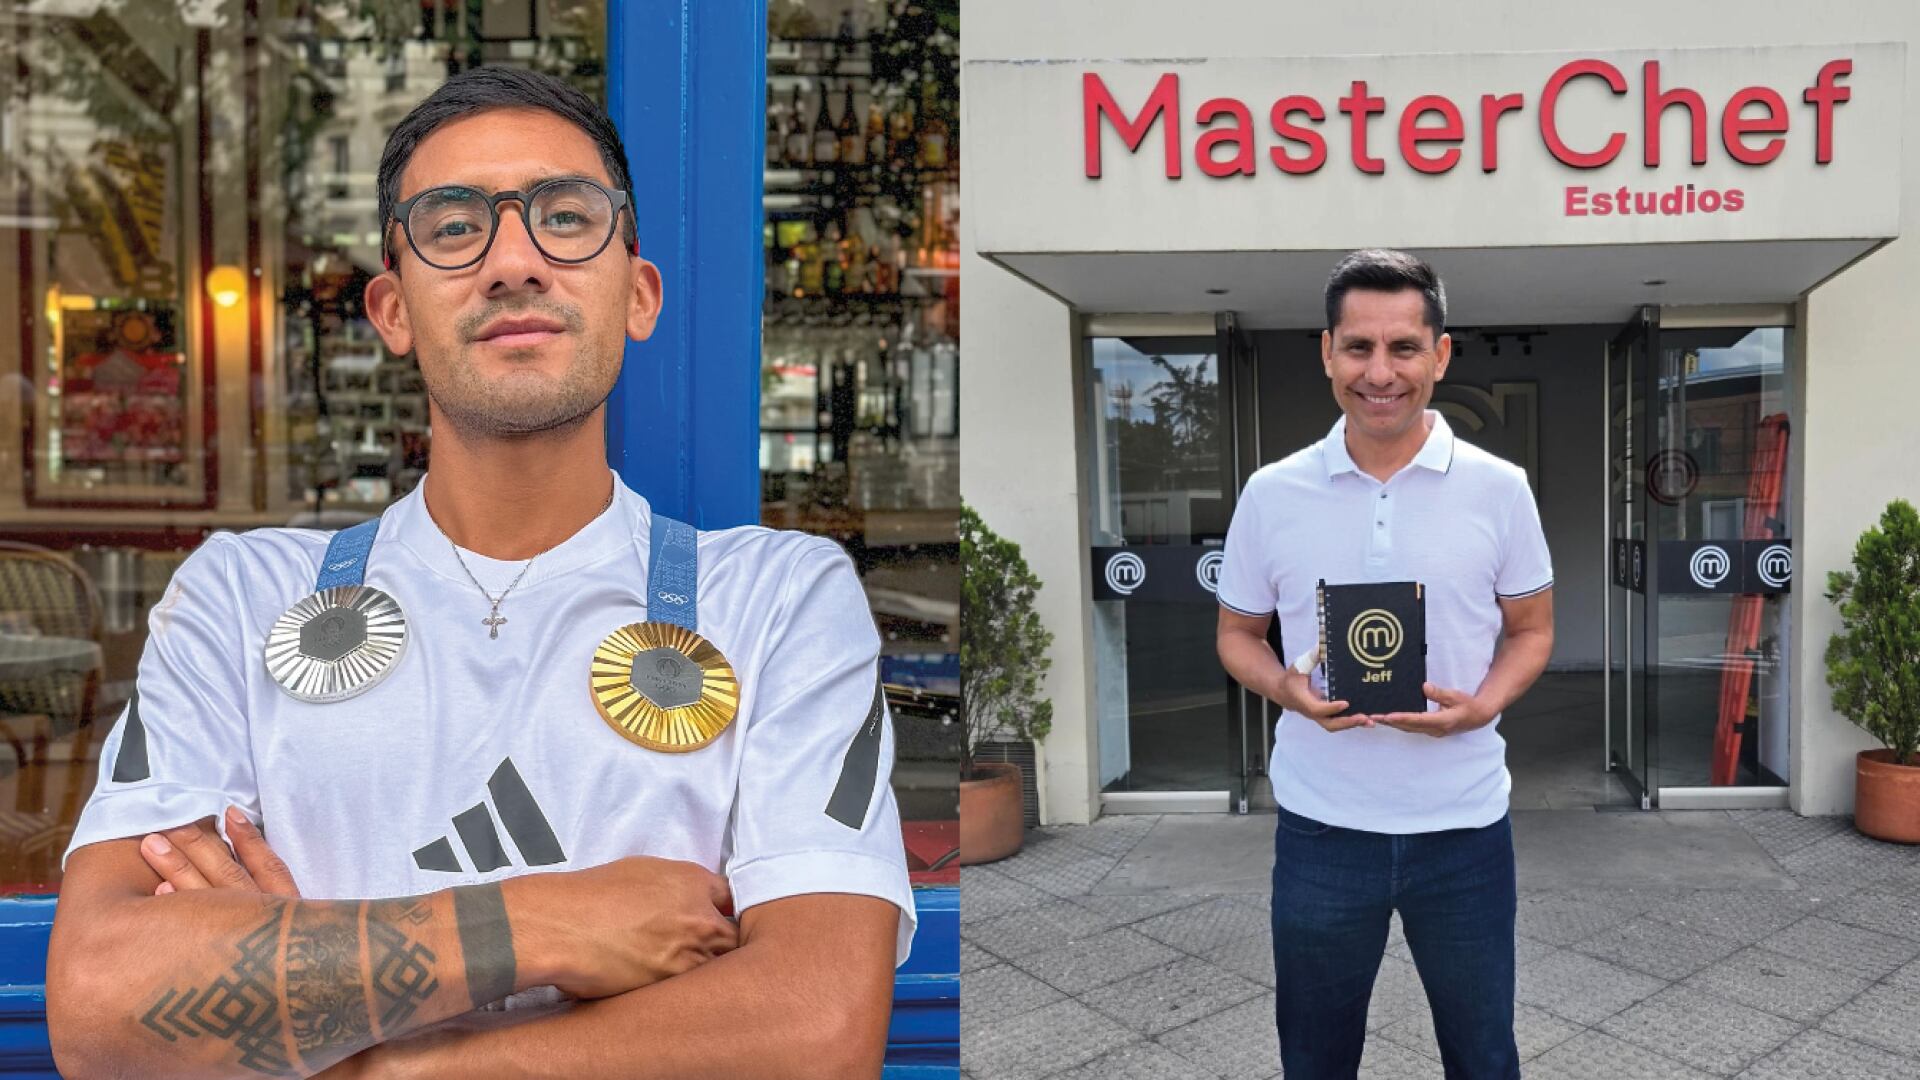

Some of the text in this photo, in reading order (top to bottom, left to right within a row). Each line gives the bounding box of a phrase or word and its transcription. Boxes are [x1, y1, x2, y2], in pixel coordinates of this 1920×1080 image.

[1083, 59, 1853, 179] MasterChef
[1565, 184, 1744, 217] Estudios
[1361, 670, 1393, 683] Jeff
